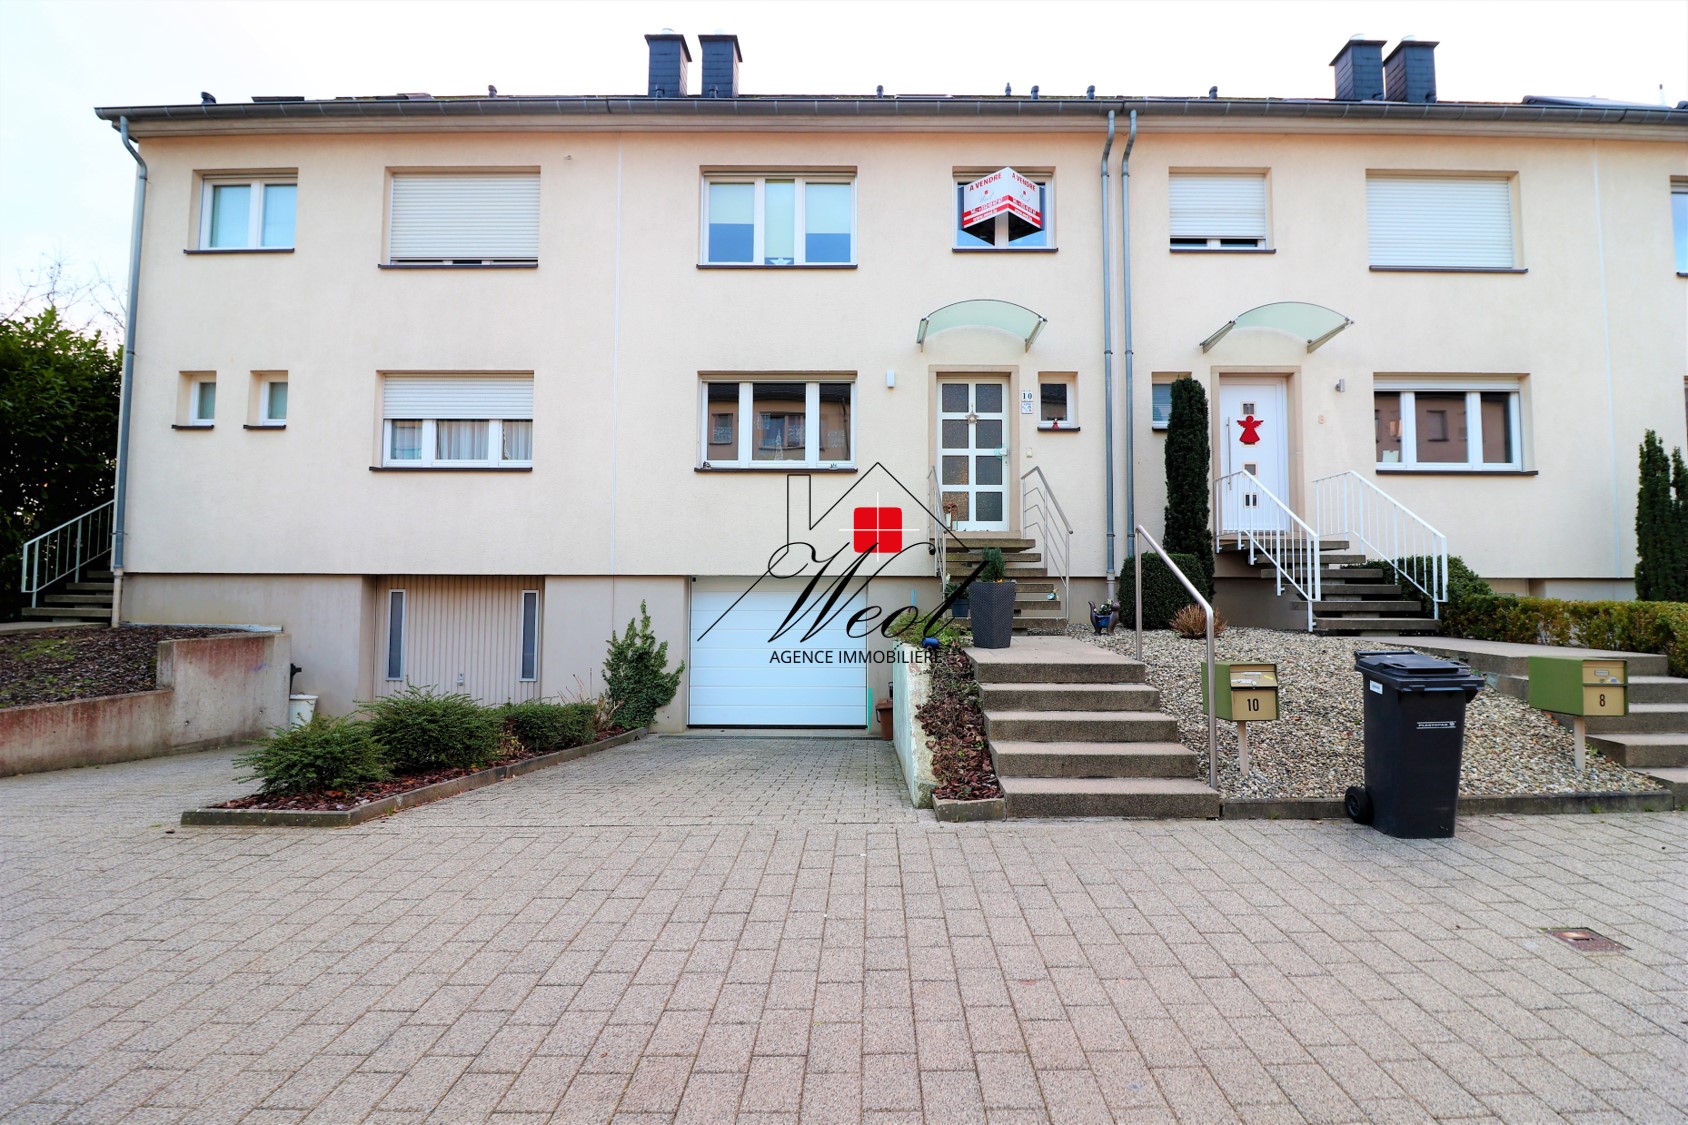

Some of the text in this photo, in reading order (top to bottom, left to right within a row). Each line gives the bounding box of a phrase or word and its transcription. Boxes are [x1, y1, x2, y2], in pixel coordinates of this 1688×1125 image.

[975, 173, 1002, 189] VENDRE
[1016, 175, 1036, 192] VENDRE
[1022, 392, 1033, 400] 10
[1247, 698, 1260, 712] 10
[1599, 693, 1606, 707] 8
